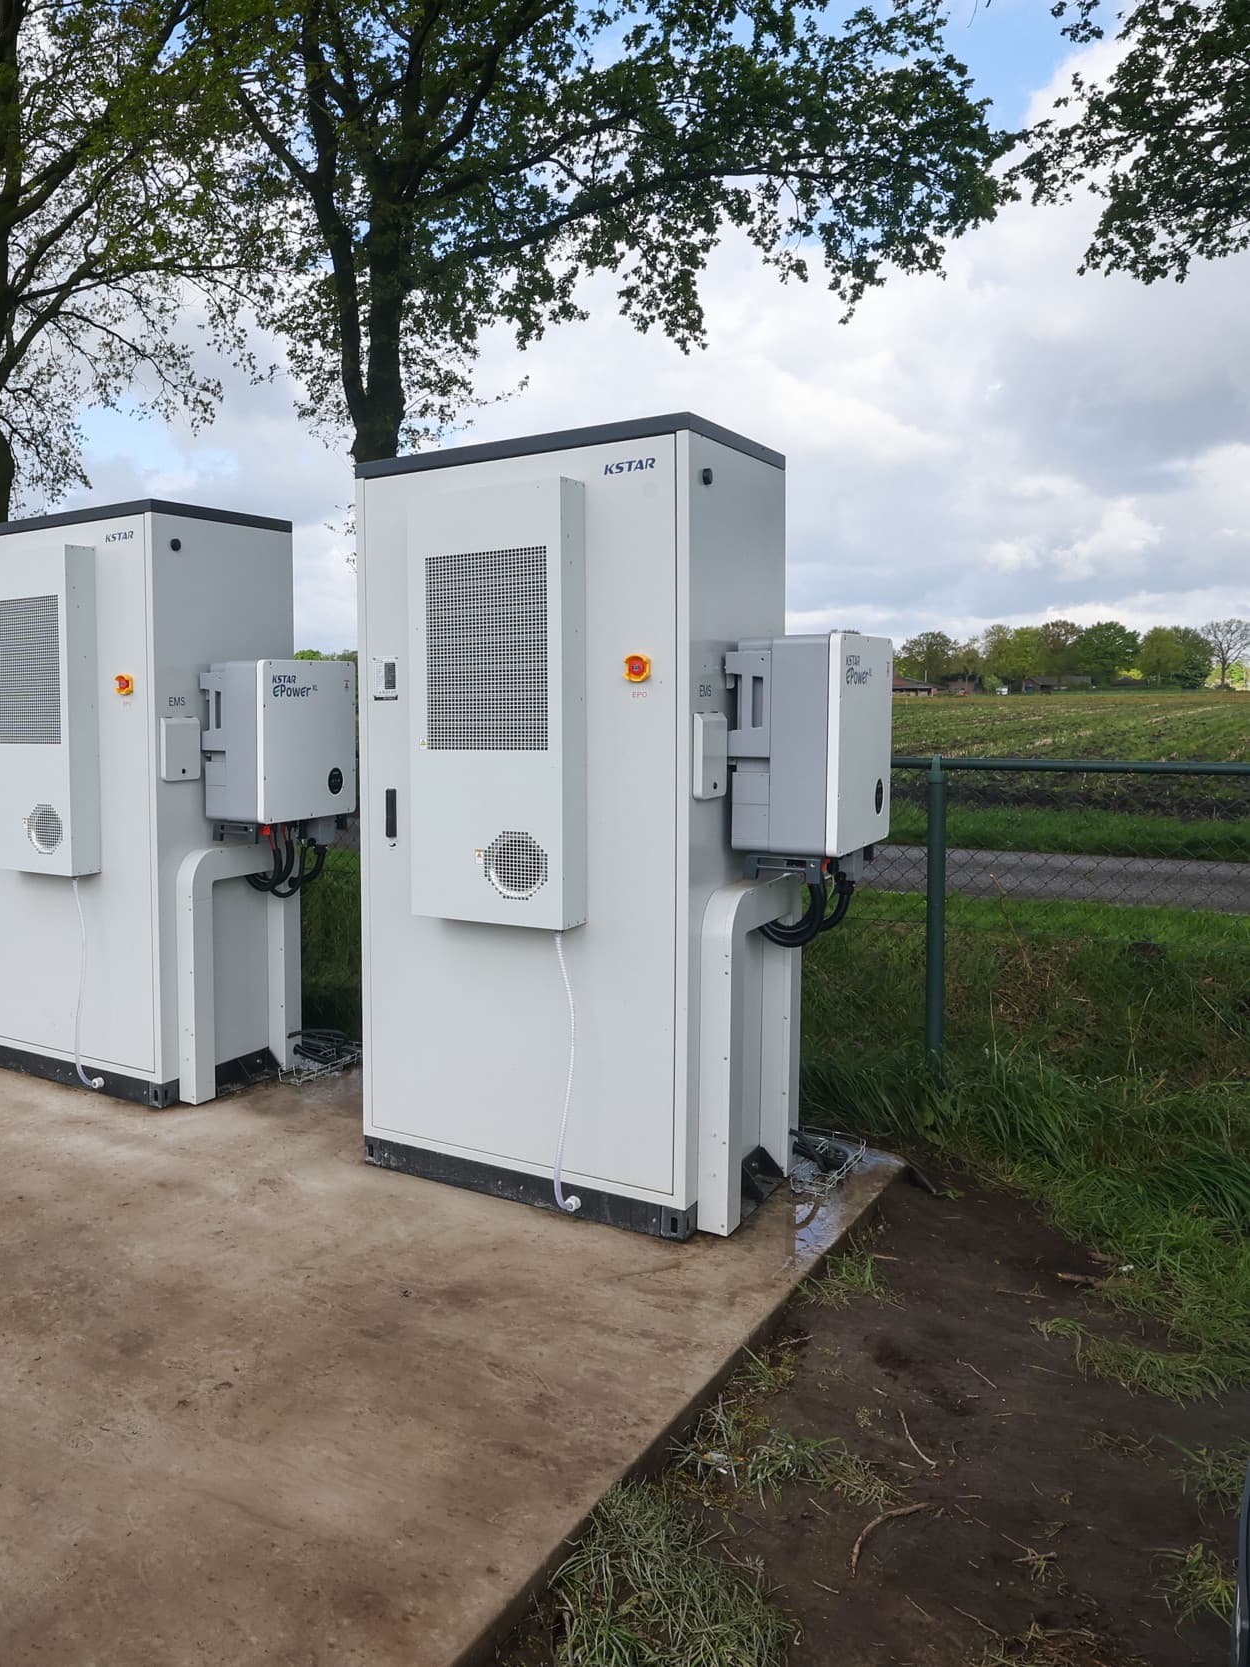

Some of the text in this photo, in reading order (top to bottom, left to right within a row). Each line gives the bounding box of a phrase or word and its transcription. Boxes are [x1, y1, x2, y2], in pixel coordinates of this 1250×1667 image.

[603, 457, 656, 476] KSTAR
[105, 530, 134, 543] KSTAR
[271, 674, 297, 684] KSTAR
[699, 684, 712, 697] EMS
[168, 696, 186, 707] EMS
